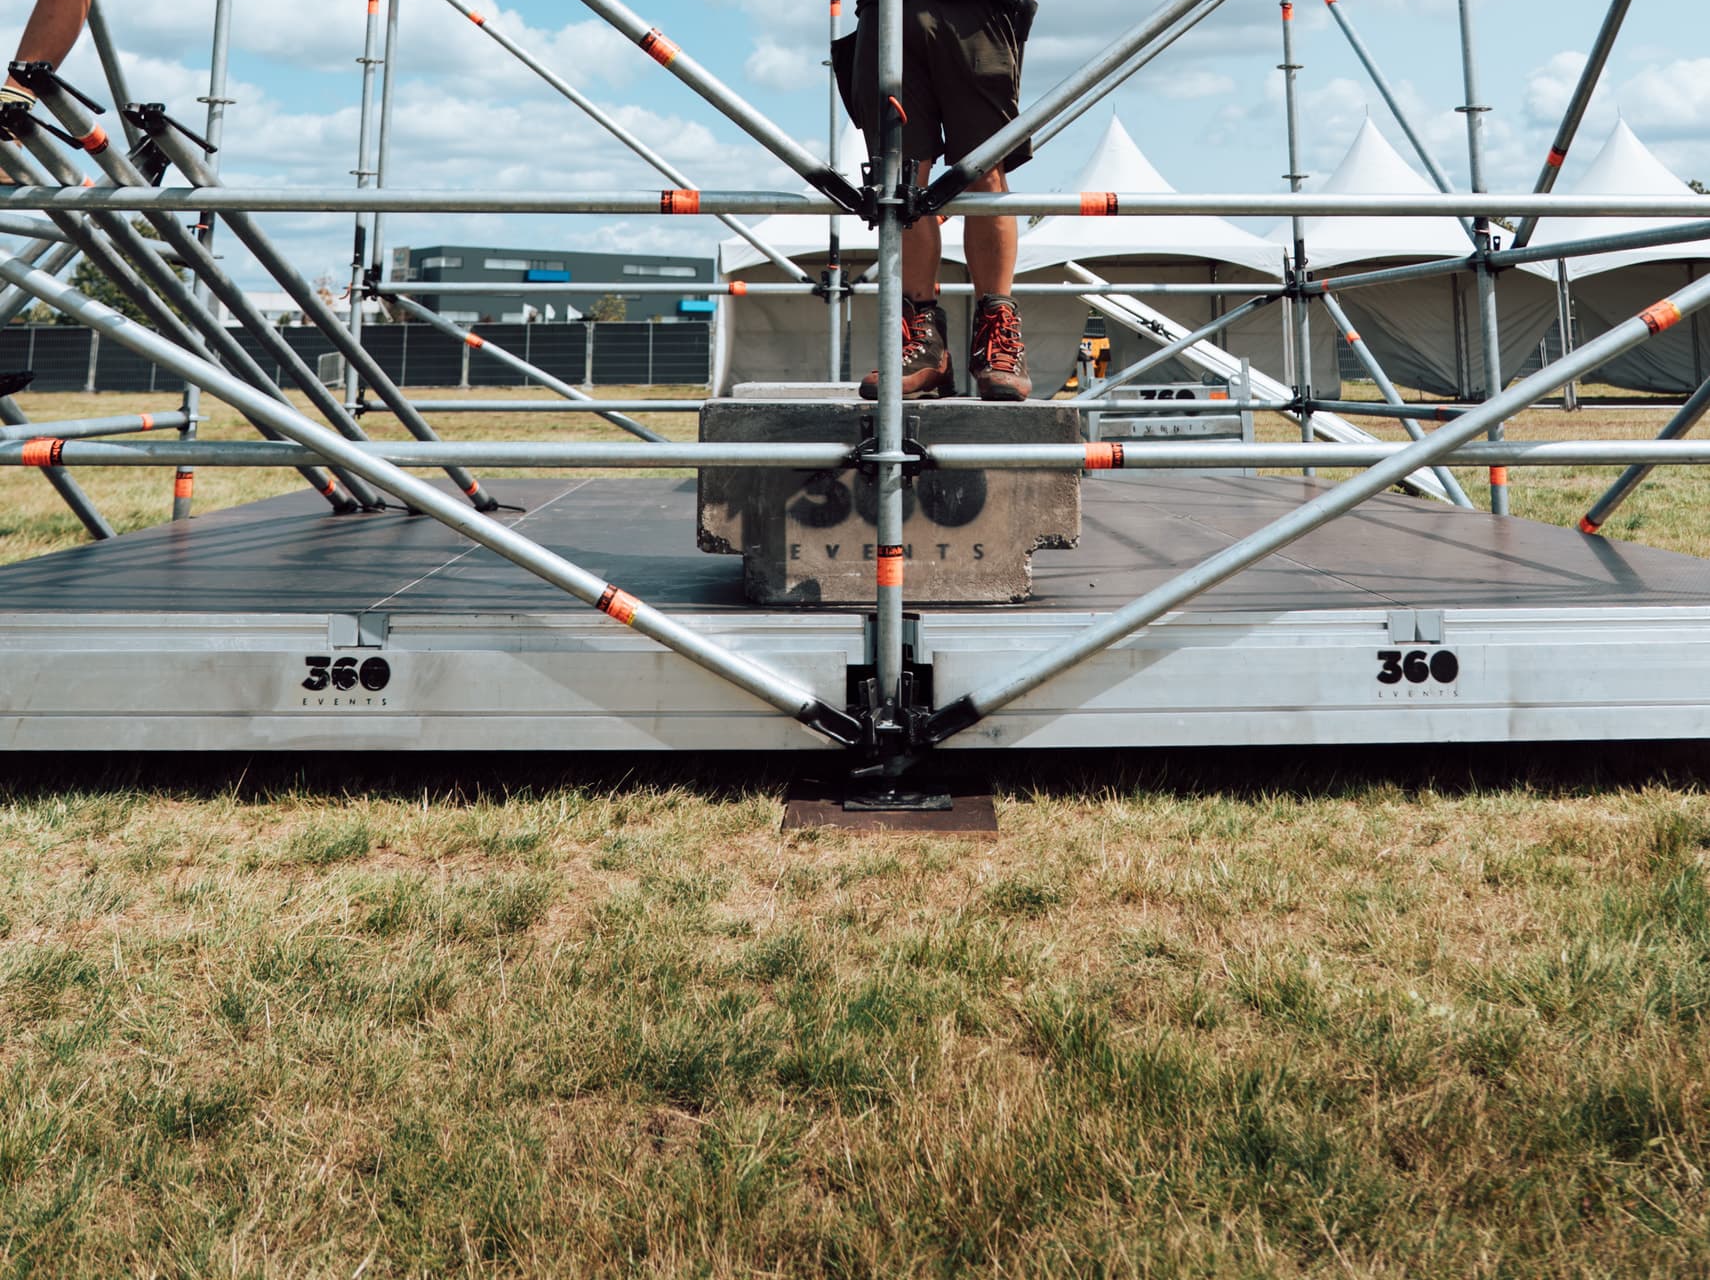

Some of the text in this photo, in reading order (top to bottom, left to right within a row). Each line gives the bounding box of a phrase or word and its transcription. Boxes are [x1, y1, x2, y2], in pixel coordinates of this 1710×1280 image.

[301, 656, 391, 692] 360
[1376, 650, 1459, 685] 360
[302, 698, 387, 706] EVENTS
